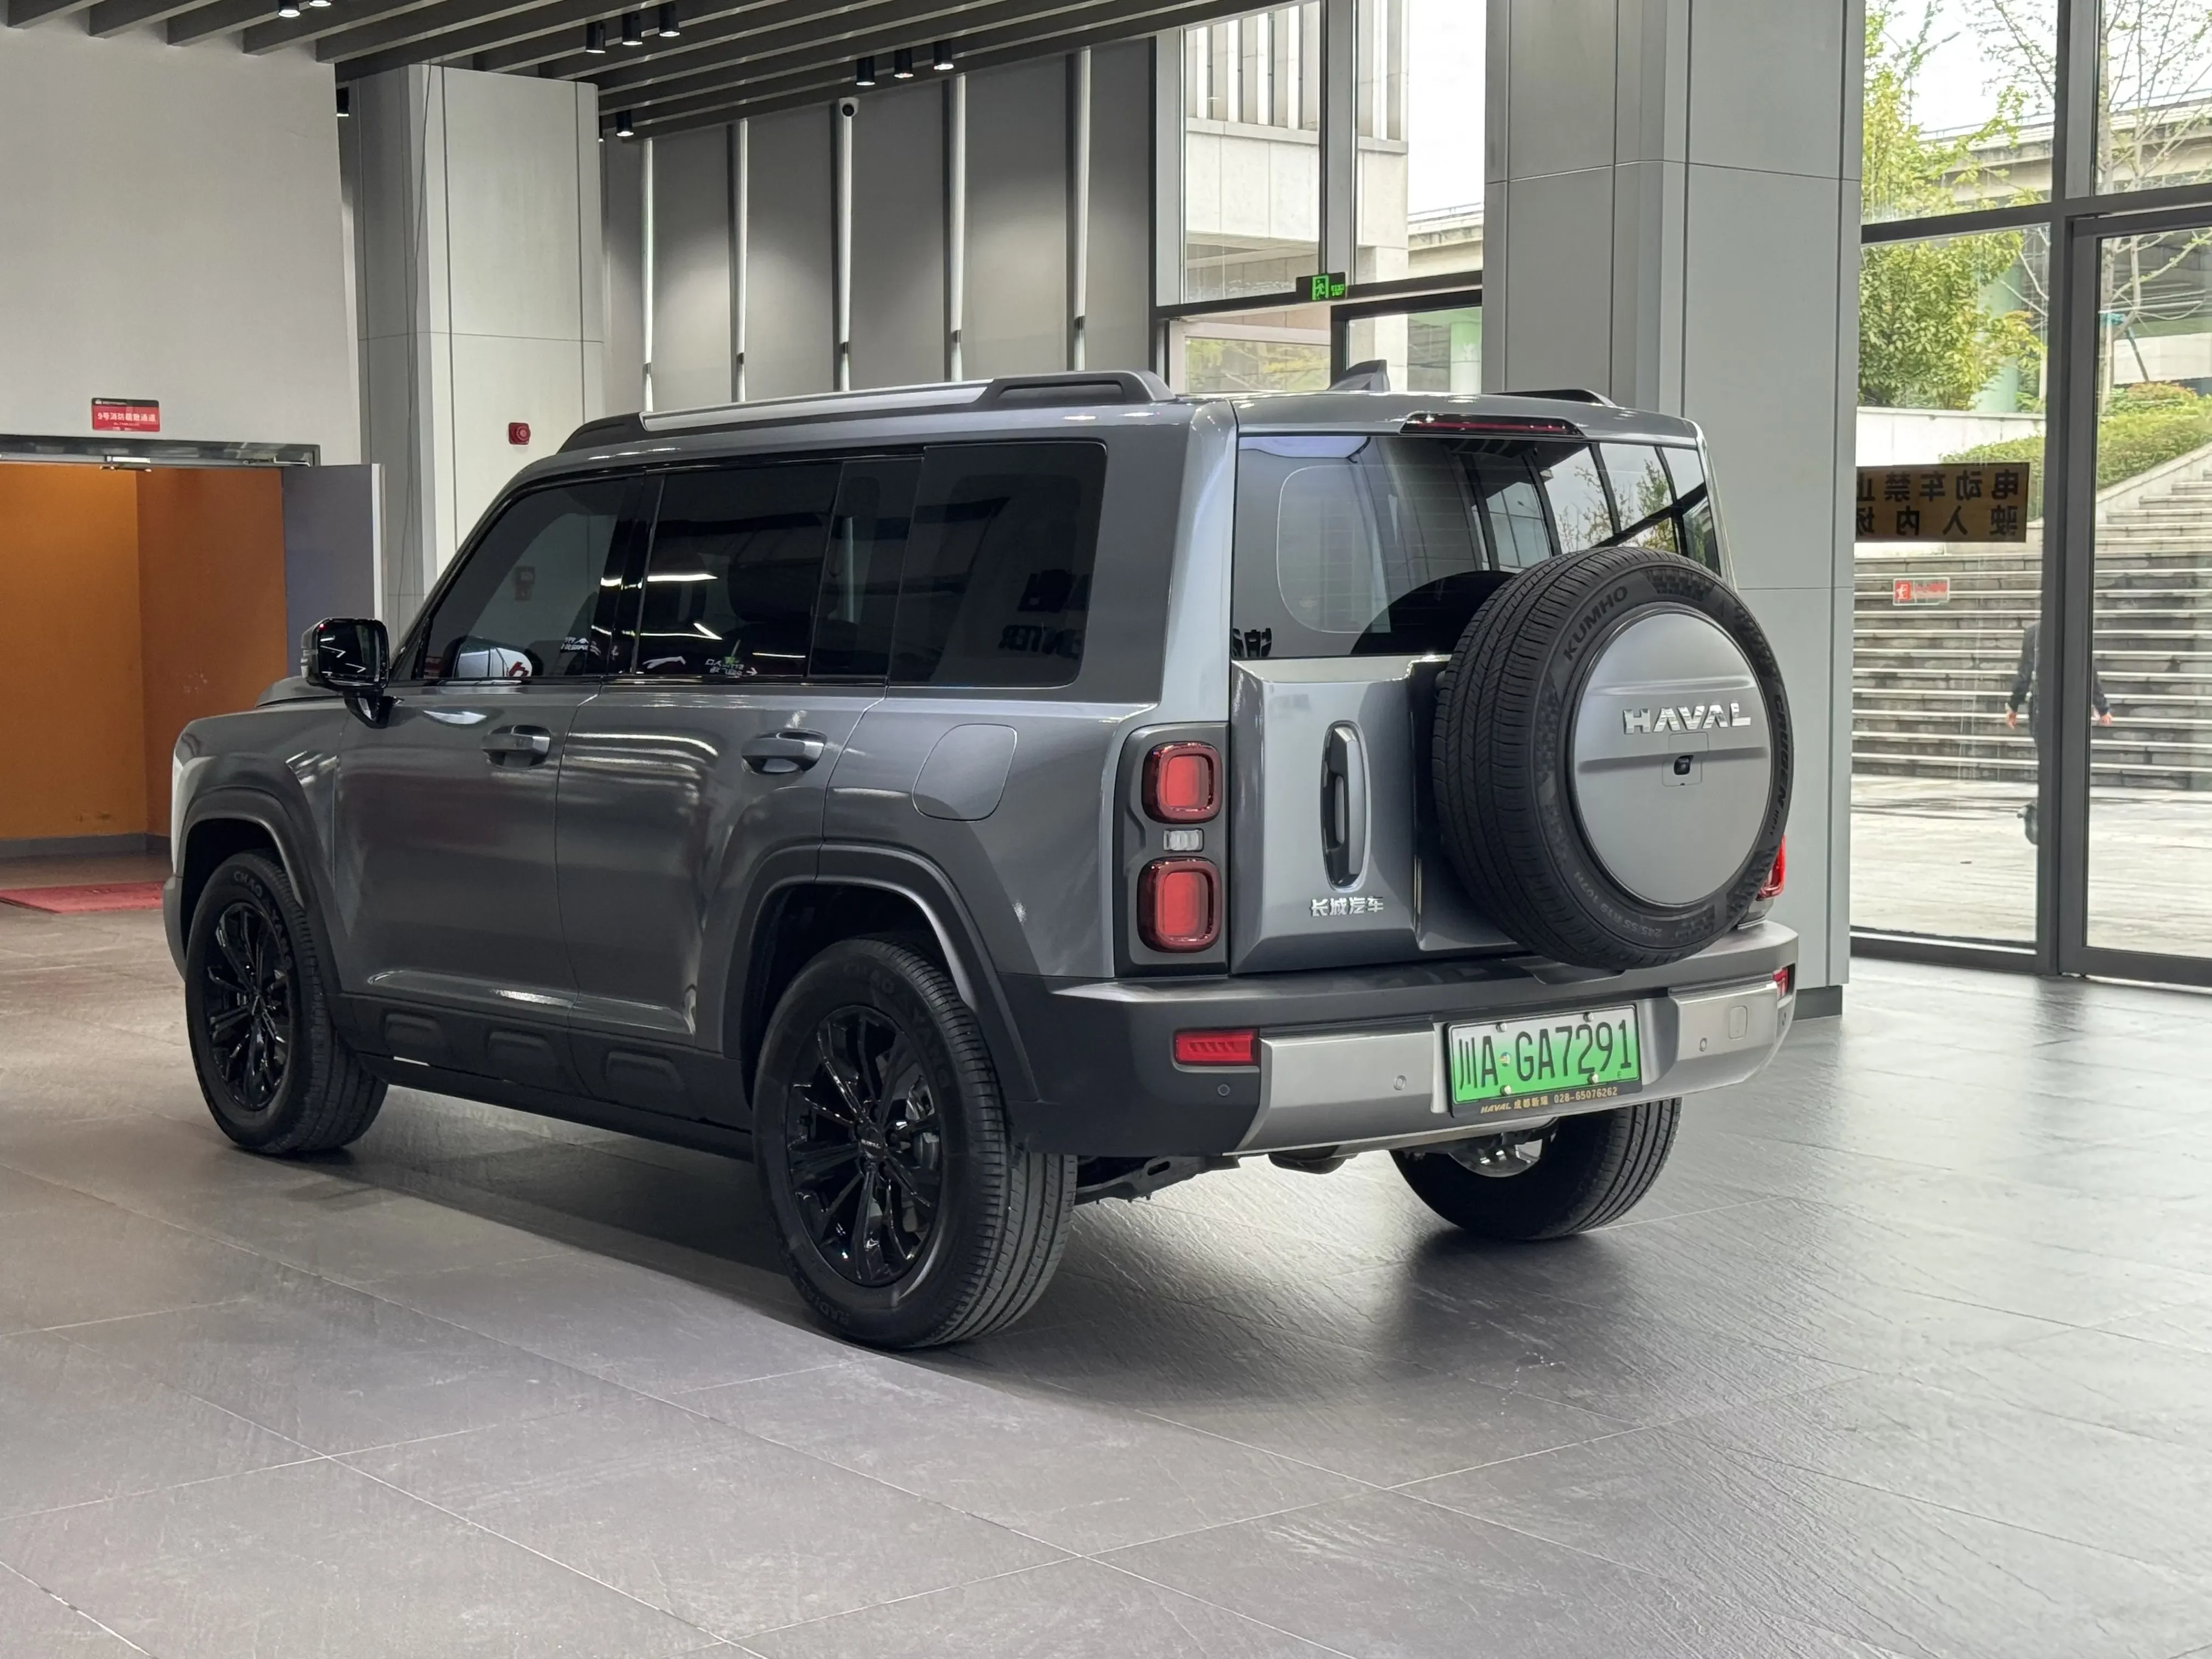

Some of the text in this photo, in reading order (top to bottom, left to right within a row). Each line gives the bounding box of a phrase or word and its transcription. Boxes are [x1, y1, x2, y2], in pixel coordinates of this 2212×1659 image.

[1563, 586, 1628, 662] KUMHO
[1622, 703, 1751, 735] HAVAL
[1310, 896, 1384, 917] 长城汽车
[1480, 1102, 1511, 1114] HAVAL
[1554, 1086, 1618, 1104] 028-65076262
